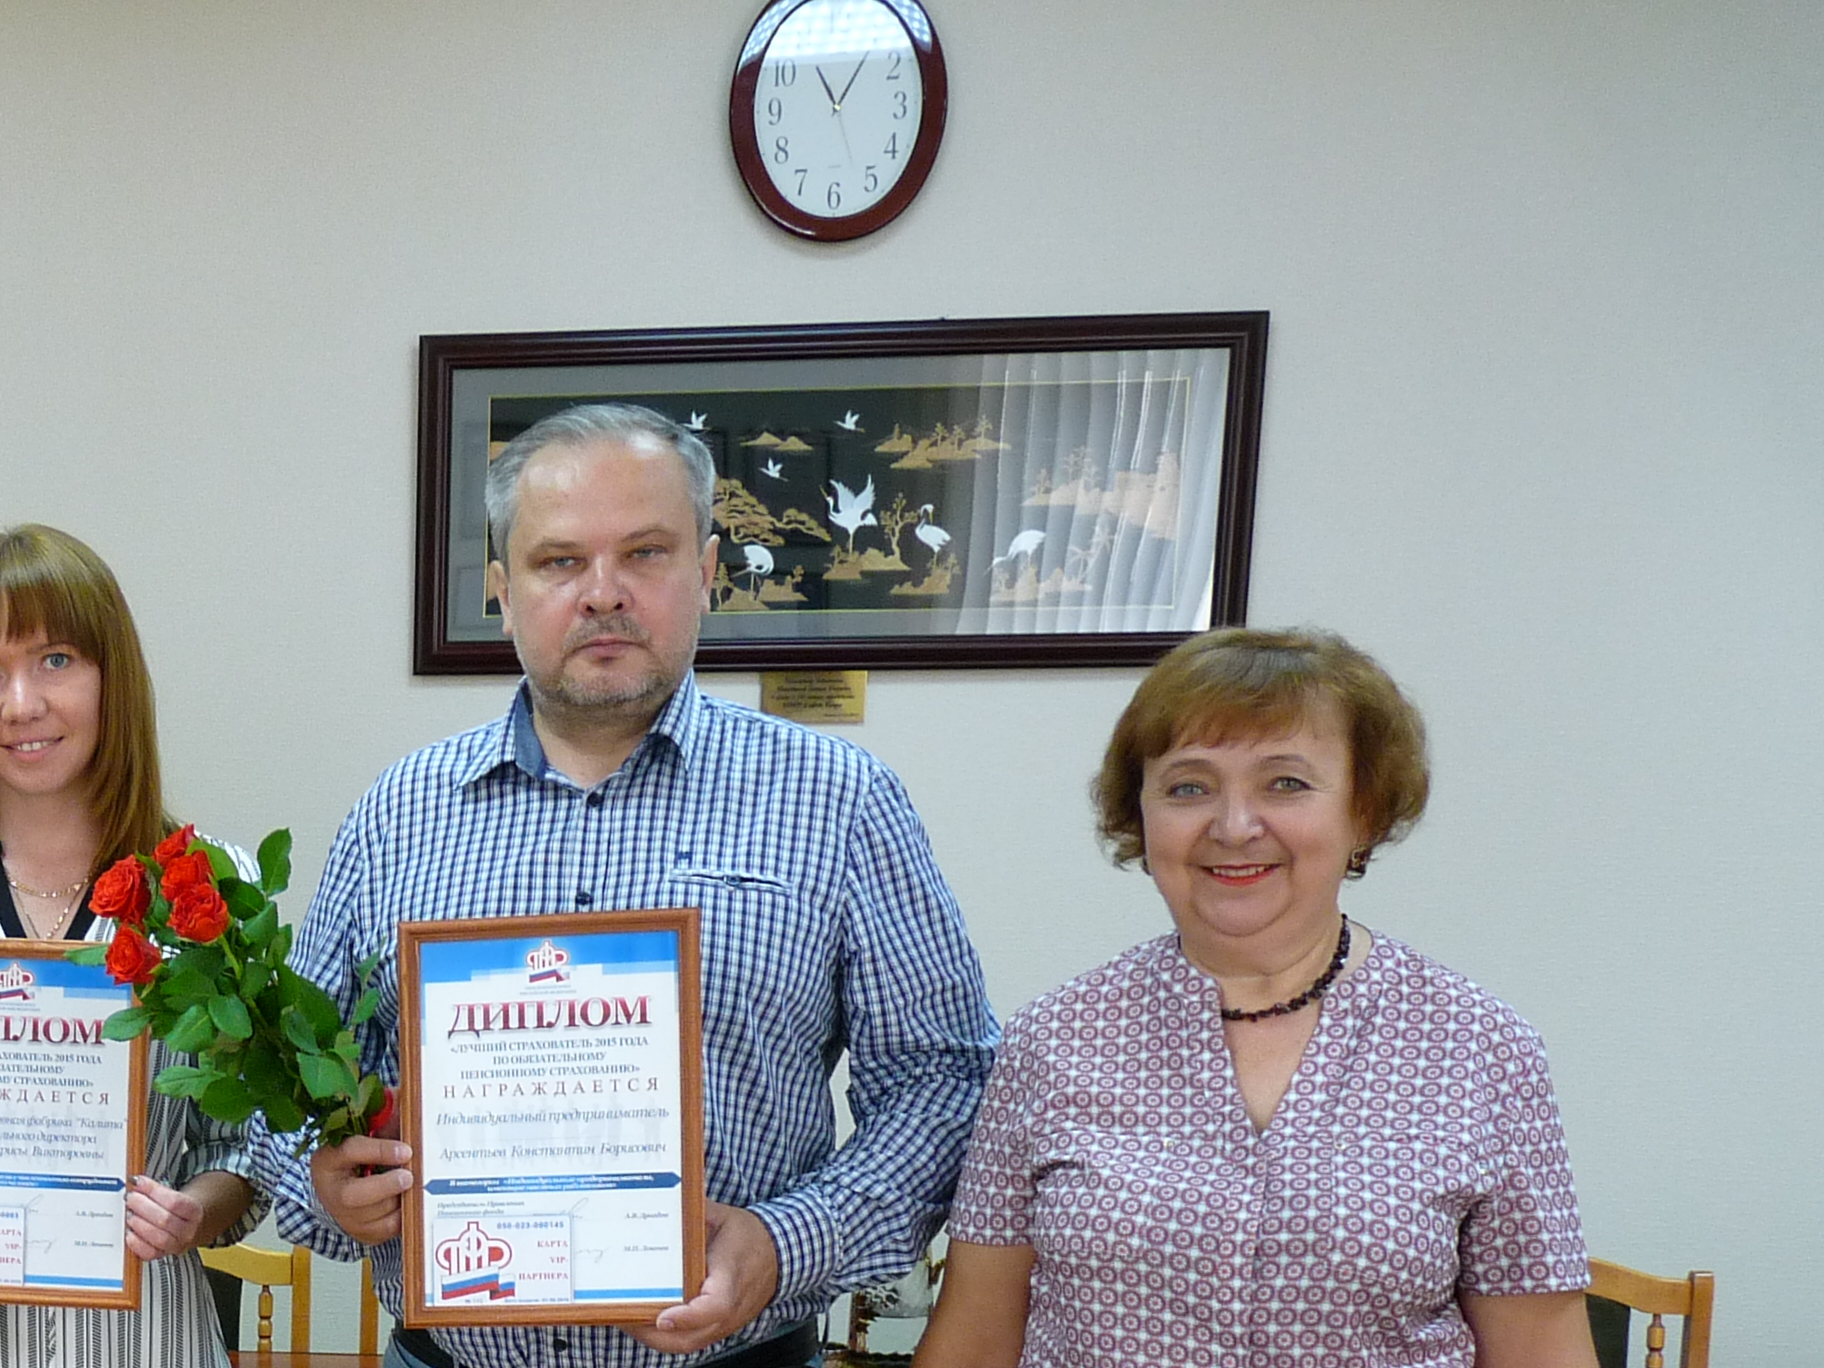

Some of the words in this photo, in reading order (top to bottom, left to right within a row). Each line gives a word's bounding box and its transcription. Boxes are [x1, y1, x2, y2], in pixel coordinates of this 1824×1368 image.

[773, 59, 796, 88] 10
[886, 51, 901, 80] 2
[768, 98, 782, 125] 9
[893, 91, 907, 120] 3
[774, 136, 789, 164] 8
[883, 132, 898, 160] 4
[794, 169, 808, 196] 7
[864, 165, 878, 192] 5
[827, 182, 841, 209] 6
[447, 995, 652, 1039] ДИПЛОМ
[509, 1038, 593, 1051] СТРАХОВАТЕЛЬ
[594, 1037, 617, 1047] 2015
[619, 1036, 649, 1047] ГОДА
[54, 1053, 74, 1063] 2015
[76, 1054, 102, 1065] ГОДА
[493, 1056, 509, 1066] ПО
[510, 1051, 606, 1065] ОБЯЗАТЕЛЬНОМУ
[460, 1067, 549, 1080] ПЕНСИОННОМУ
[443, 1077, 659, 1099] НАГРАЖДАЕТСЯ
[436, 1108, 546, 1126] Индивидуальный
[548, 1105, 670, 1123] предприниматель
[511, 1144, 595, 1157] Константин
[600, 1140, 667, 1157] Борисович
[537, 1240, 568, 1248] КАРТА
[518, 1272, 569, 1281] ПАРТНЕРА
